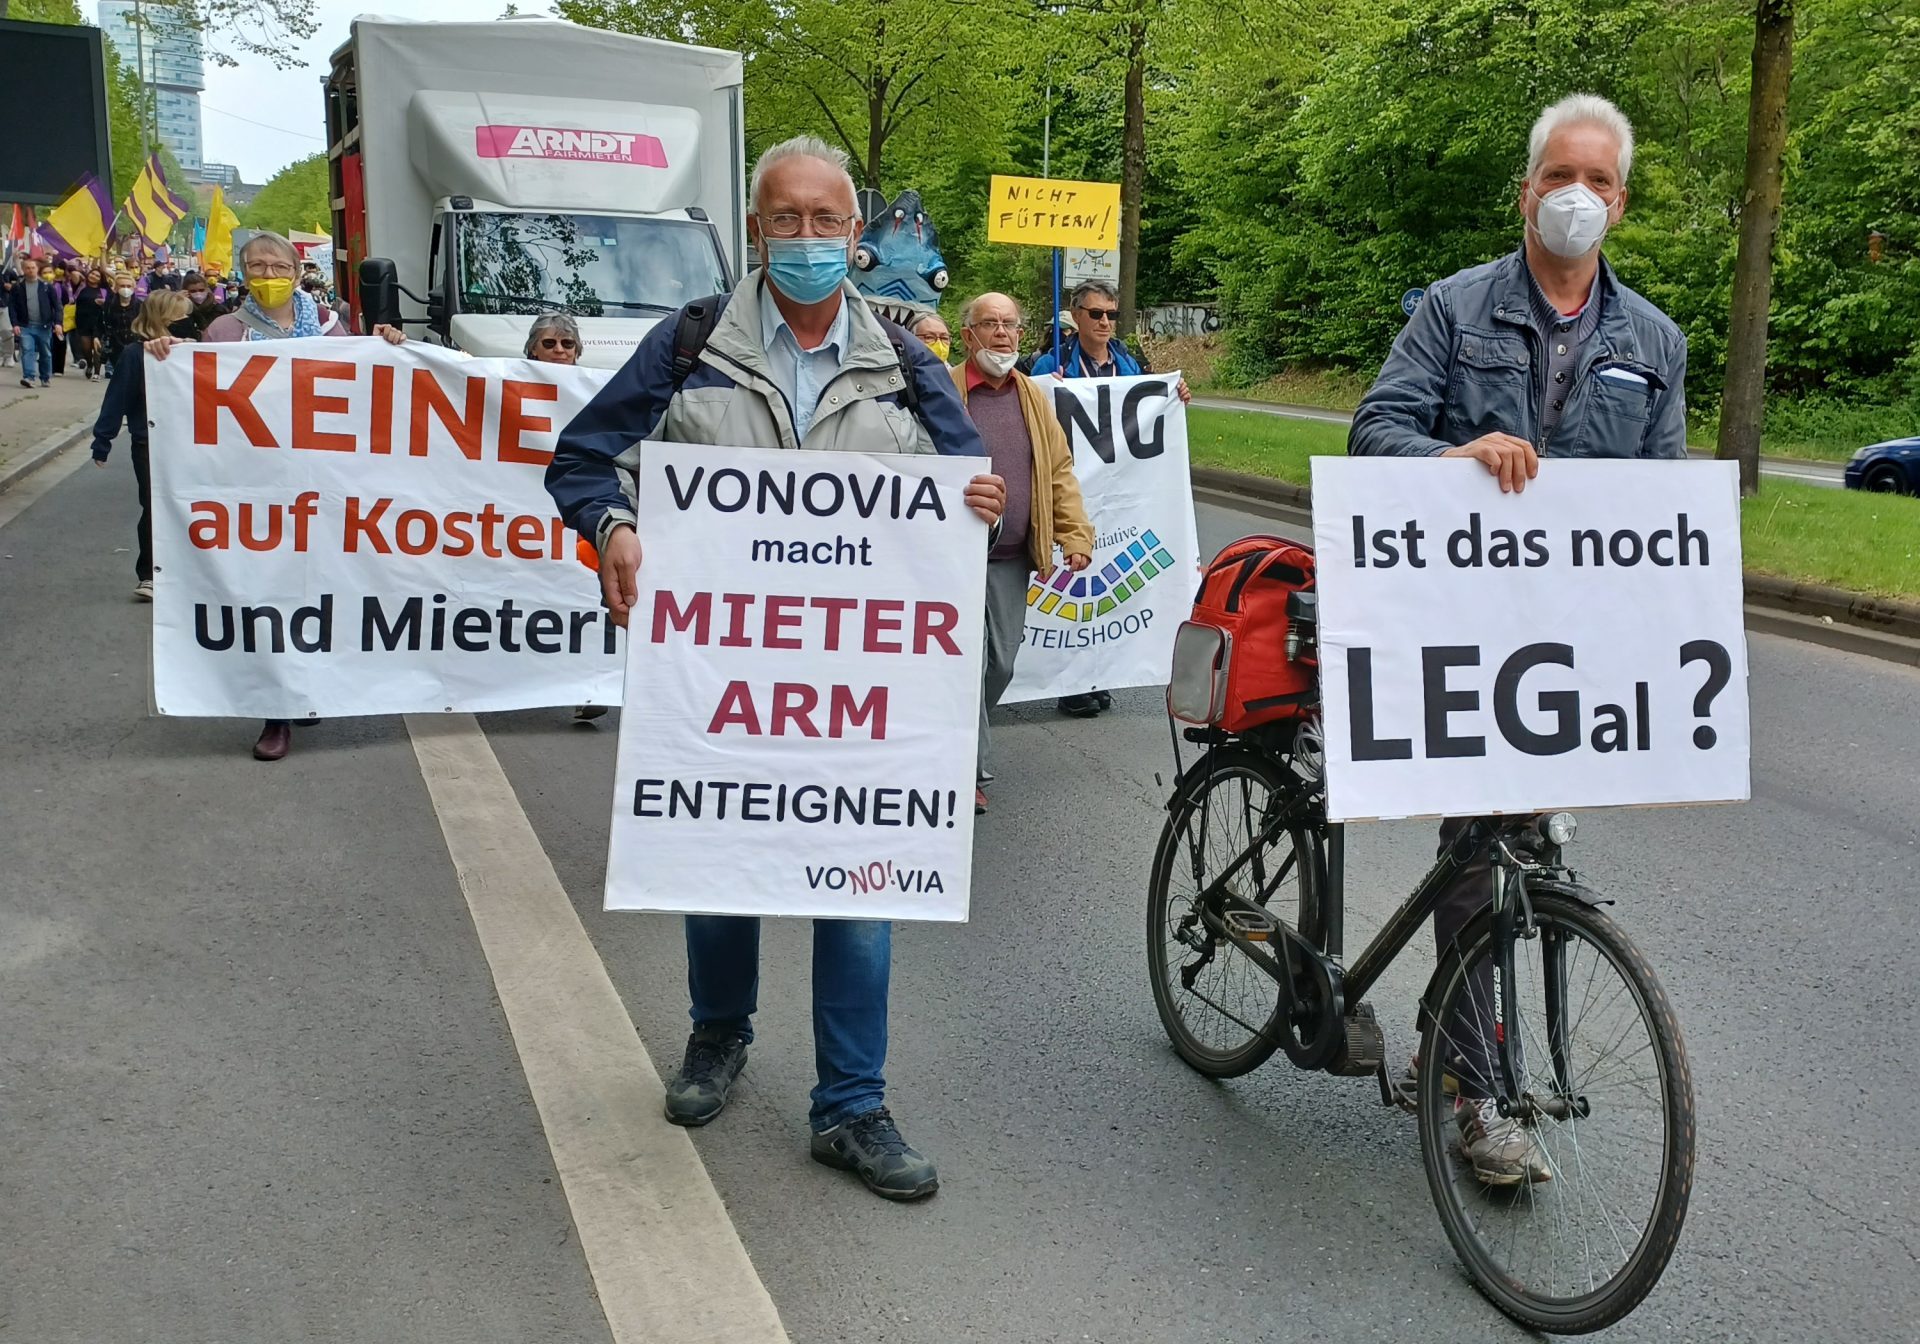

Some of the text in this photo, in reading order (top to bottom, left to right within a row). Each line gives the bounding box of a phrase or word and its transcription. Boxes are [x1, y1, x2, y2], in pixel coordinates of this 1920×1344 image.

[507, 128, 636, 156] ARNDT
[545, 150, 633, 162] FAIRMIETEN
[1007, 186, 1077, 205] NICHT
[1000, 206, 1111, 241] FÜTTERN!
[193, 351, 558, 467] KEINE
[665, 465, 946, 521] VONOVIA
[189, 491, 320, 552] auf
[1352, 513, 1709, 568] Ist das noch
[751, 535, 872, 566] macht
[194, 594, 333, 653] und
[651, 590, 963, 656] MIETER
[706, 680, 889, 740] ARM
[1346, 640, 1731, 762] LEGal ?
[632, 779, 957, 829] ENTEIGNEN!
